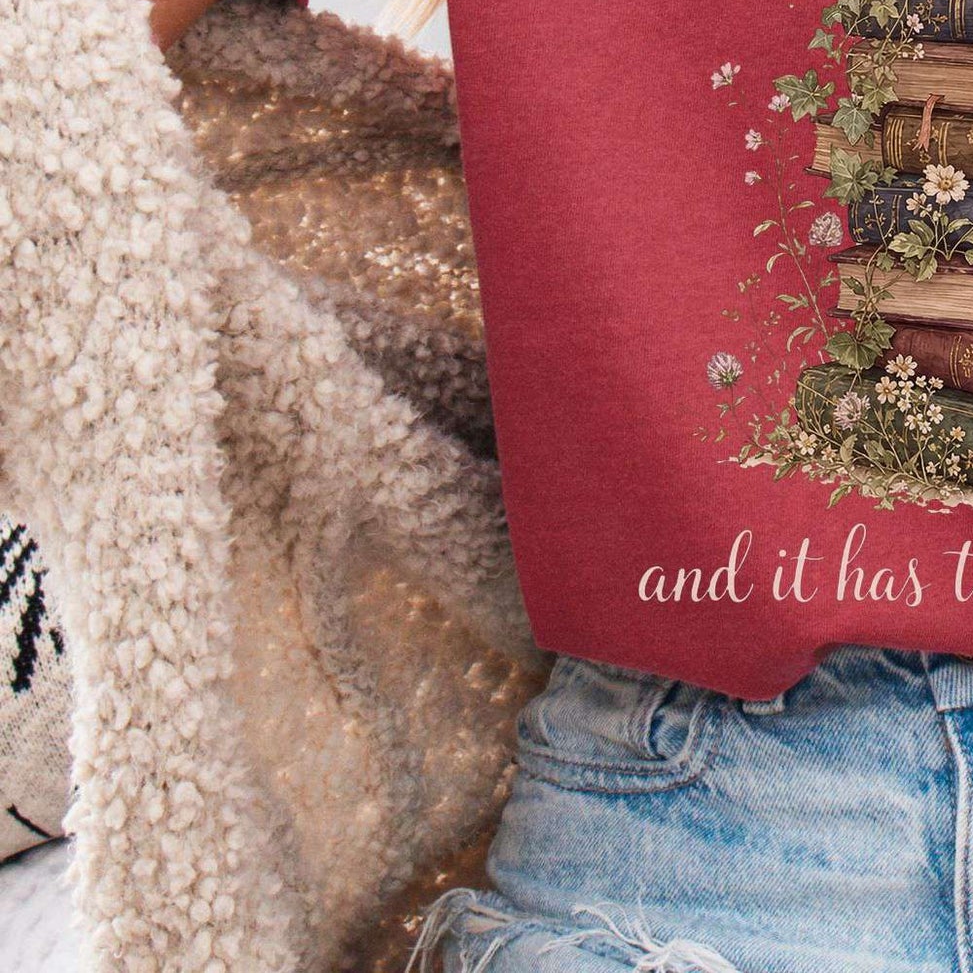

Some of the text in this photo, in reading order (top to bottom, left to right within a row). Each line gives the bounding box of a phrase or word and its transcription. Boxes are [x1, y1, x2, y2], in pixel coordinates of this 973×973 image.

[638, 530, 754, 603] and
[772, 538, 825, 603] it
[836, 523, 932, 607] has
